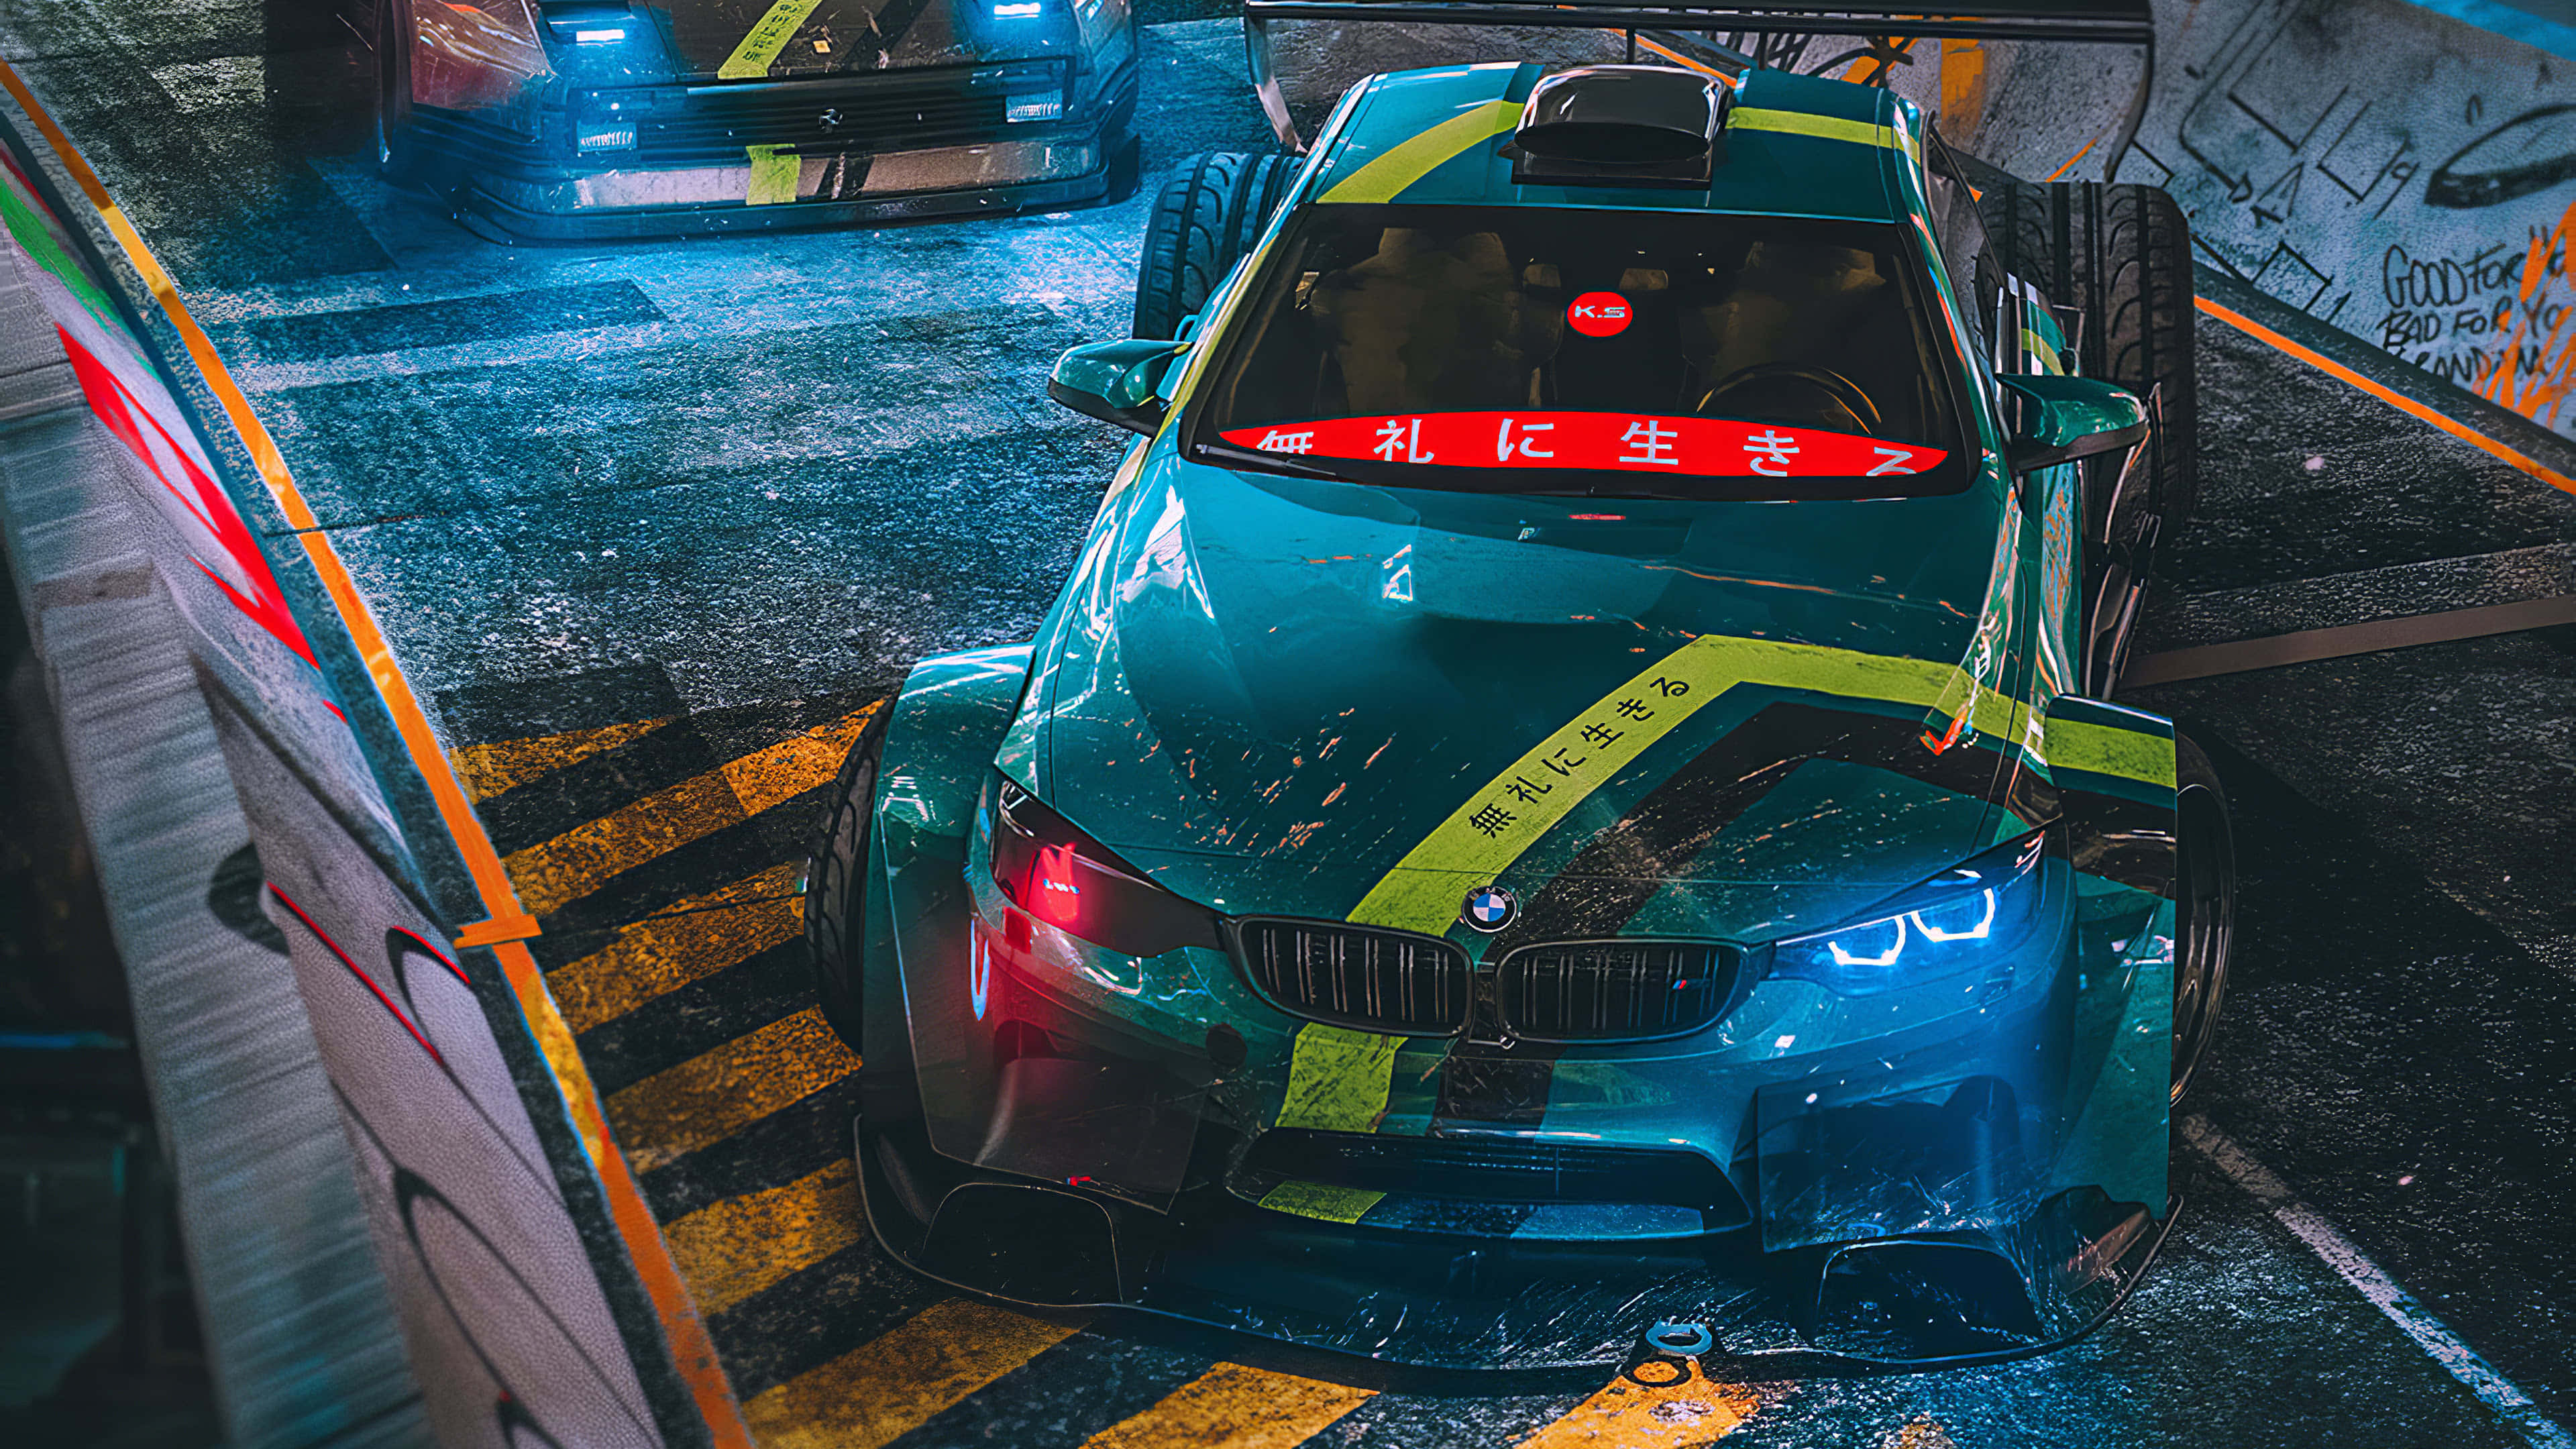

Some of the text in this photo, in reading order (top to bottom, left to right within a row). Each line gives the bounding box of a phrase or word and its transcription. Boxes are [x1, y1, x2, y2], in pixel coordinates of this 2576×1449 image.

[2383, 244, 2467, 309] GOOD
[2376, 310, 2441, 351] BAD
[2452, 295, 2511, 336] FOR
[1469, 676, 1690, 839] 無礼に生きる
